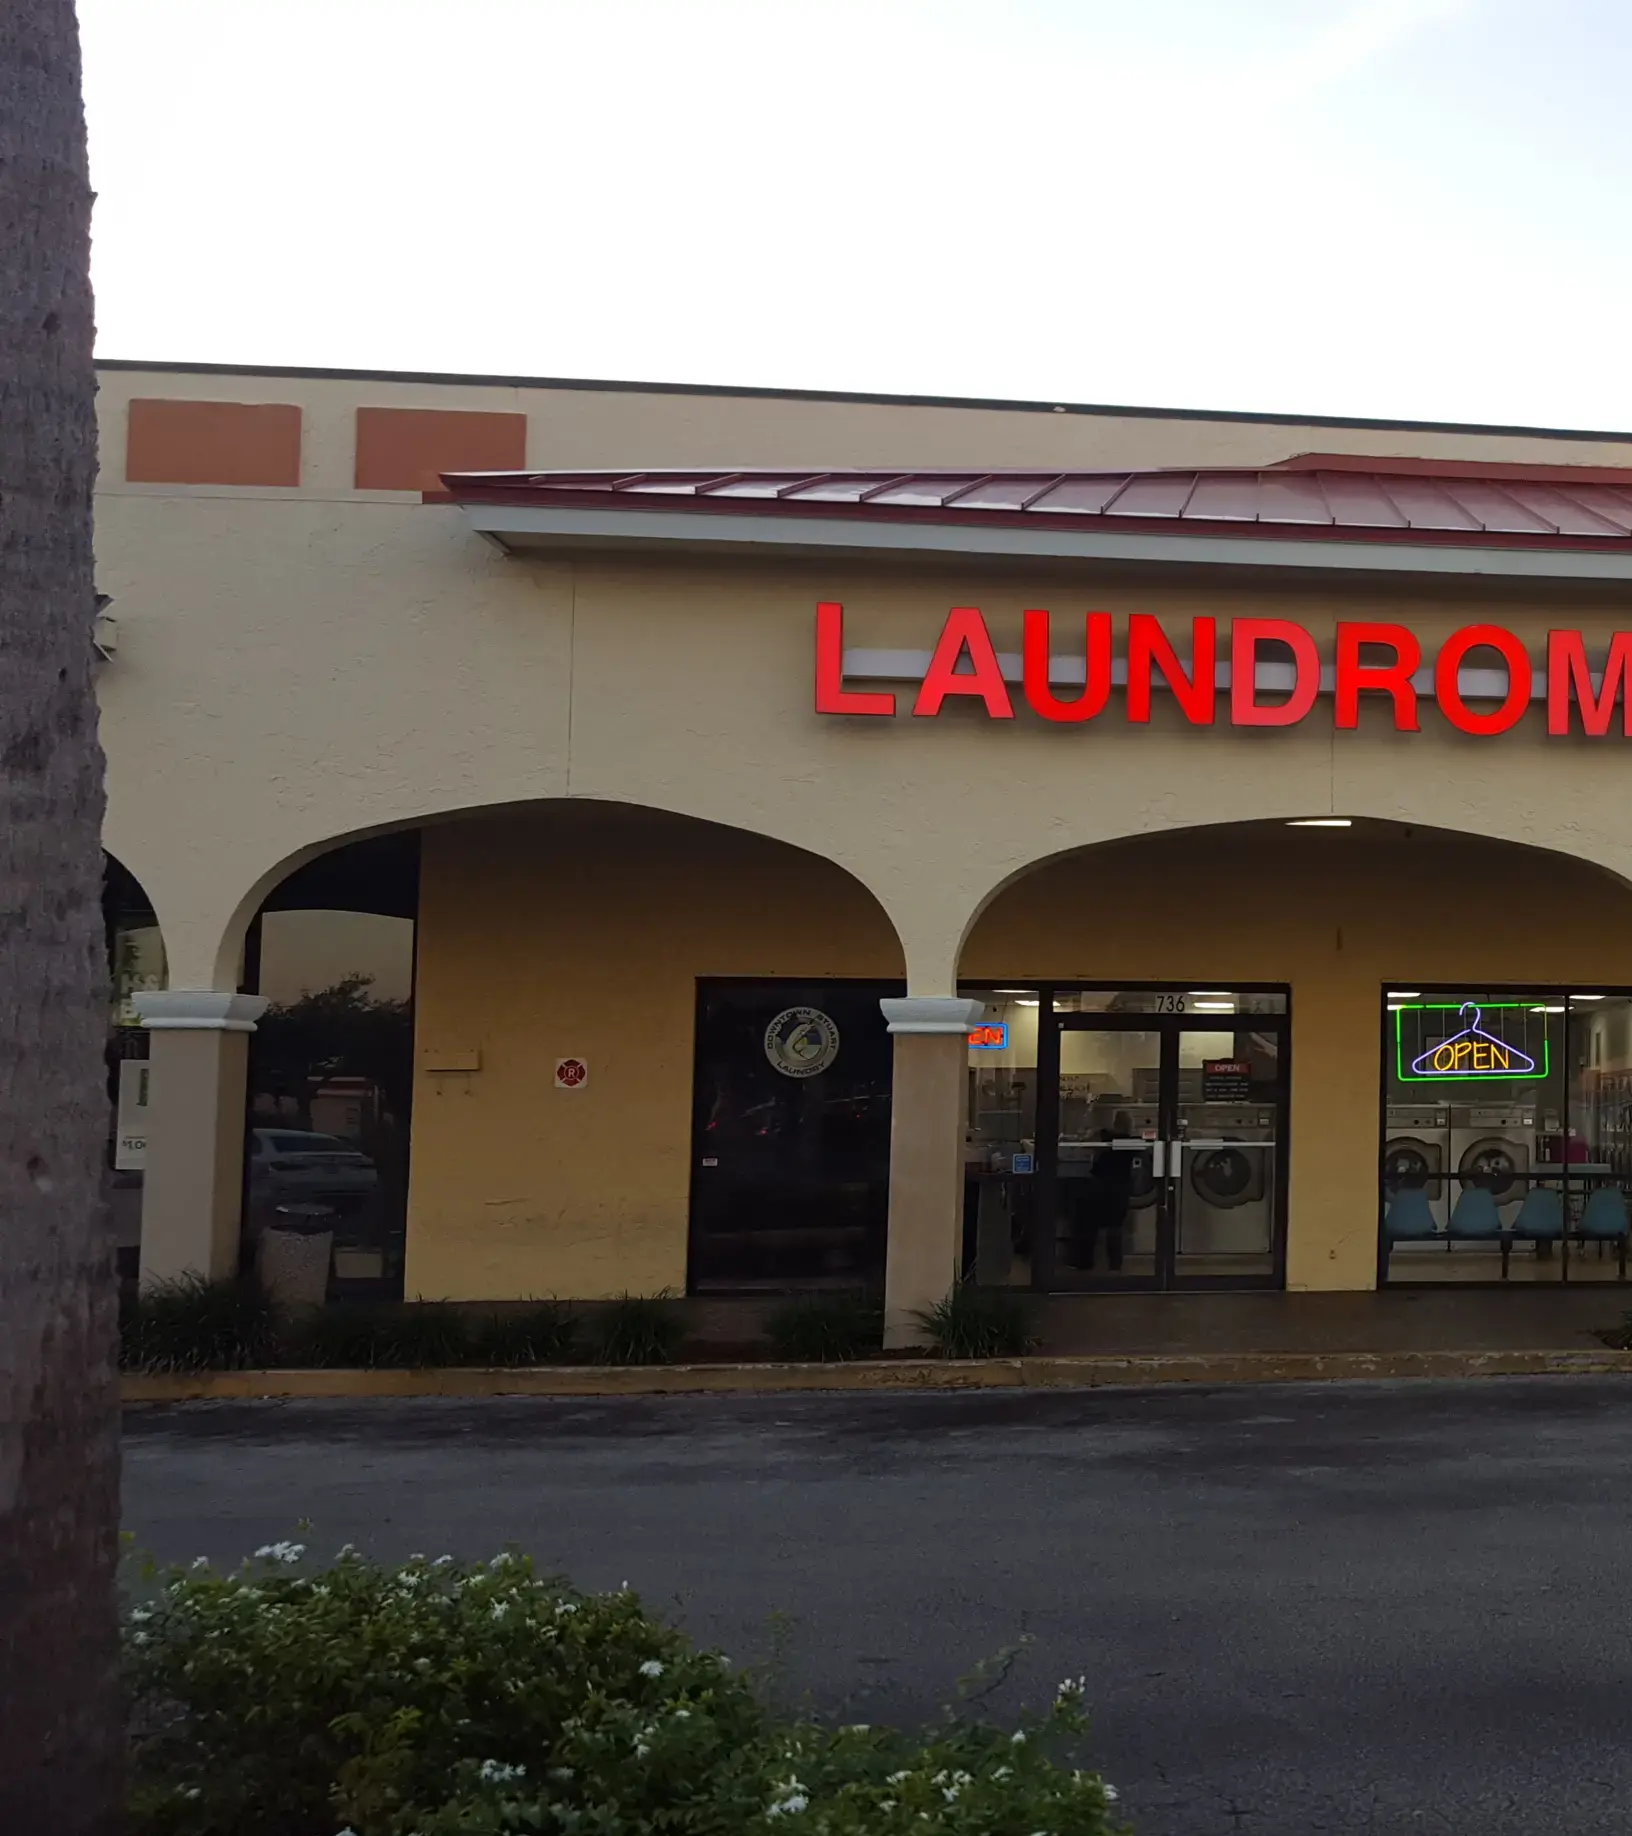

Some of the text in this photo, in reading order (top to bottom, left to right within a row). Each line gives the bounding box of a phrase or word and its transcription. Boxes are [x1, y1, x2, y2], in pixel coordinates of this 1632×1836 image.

[1157, 995, 1185, 1013] 736
[767, 1009, 837, 1050] DOWNTOWN STUART
[1434, 1041, 1509, 1071] OPEN
[568, 1067, 576, 1078] R
[776, 1060, 825, 1075] LAUNDRY
[1215, 1063, 1240, 1073] OPEN
